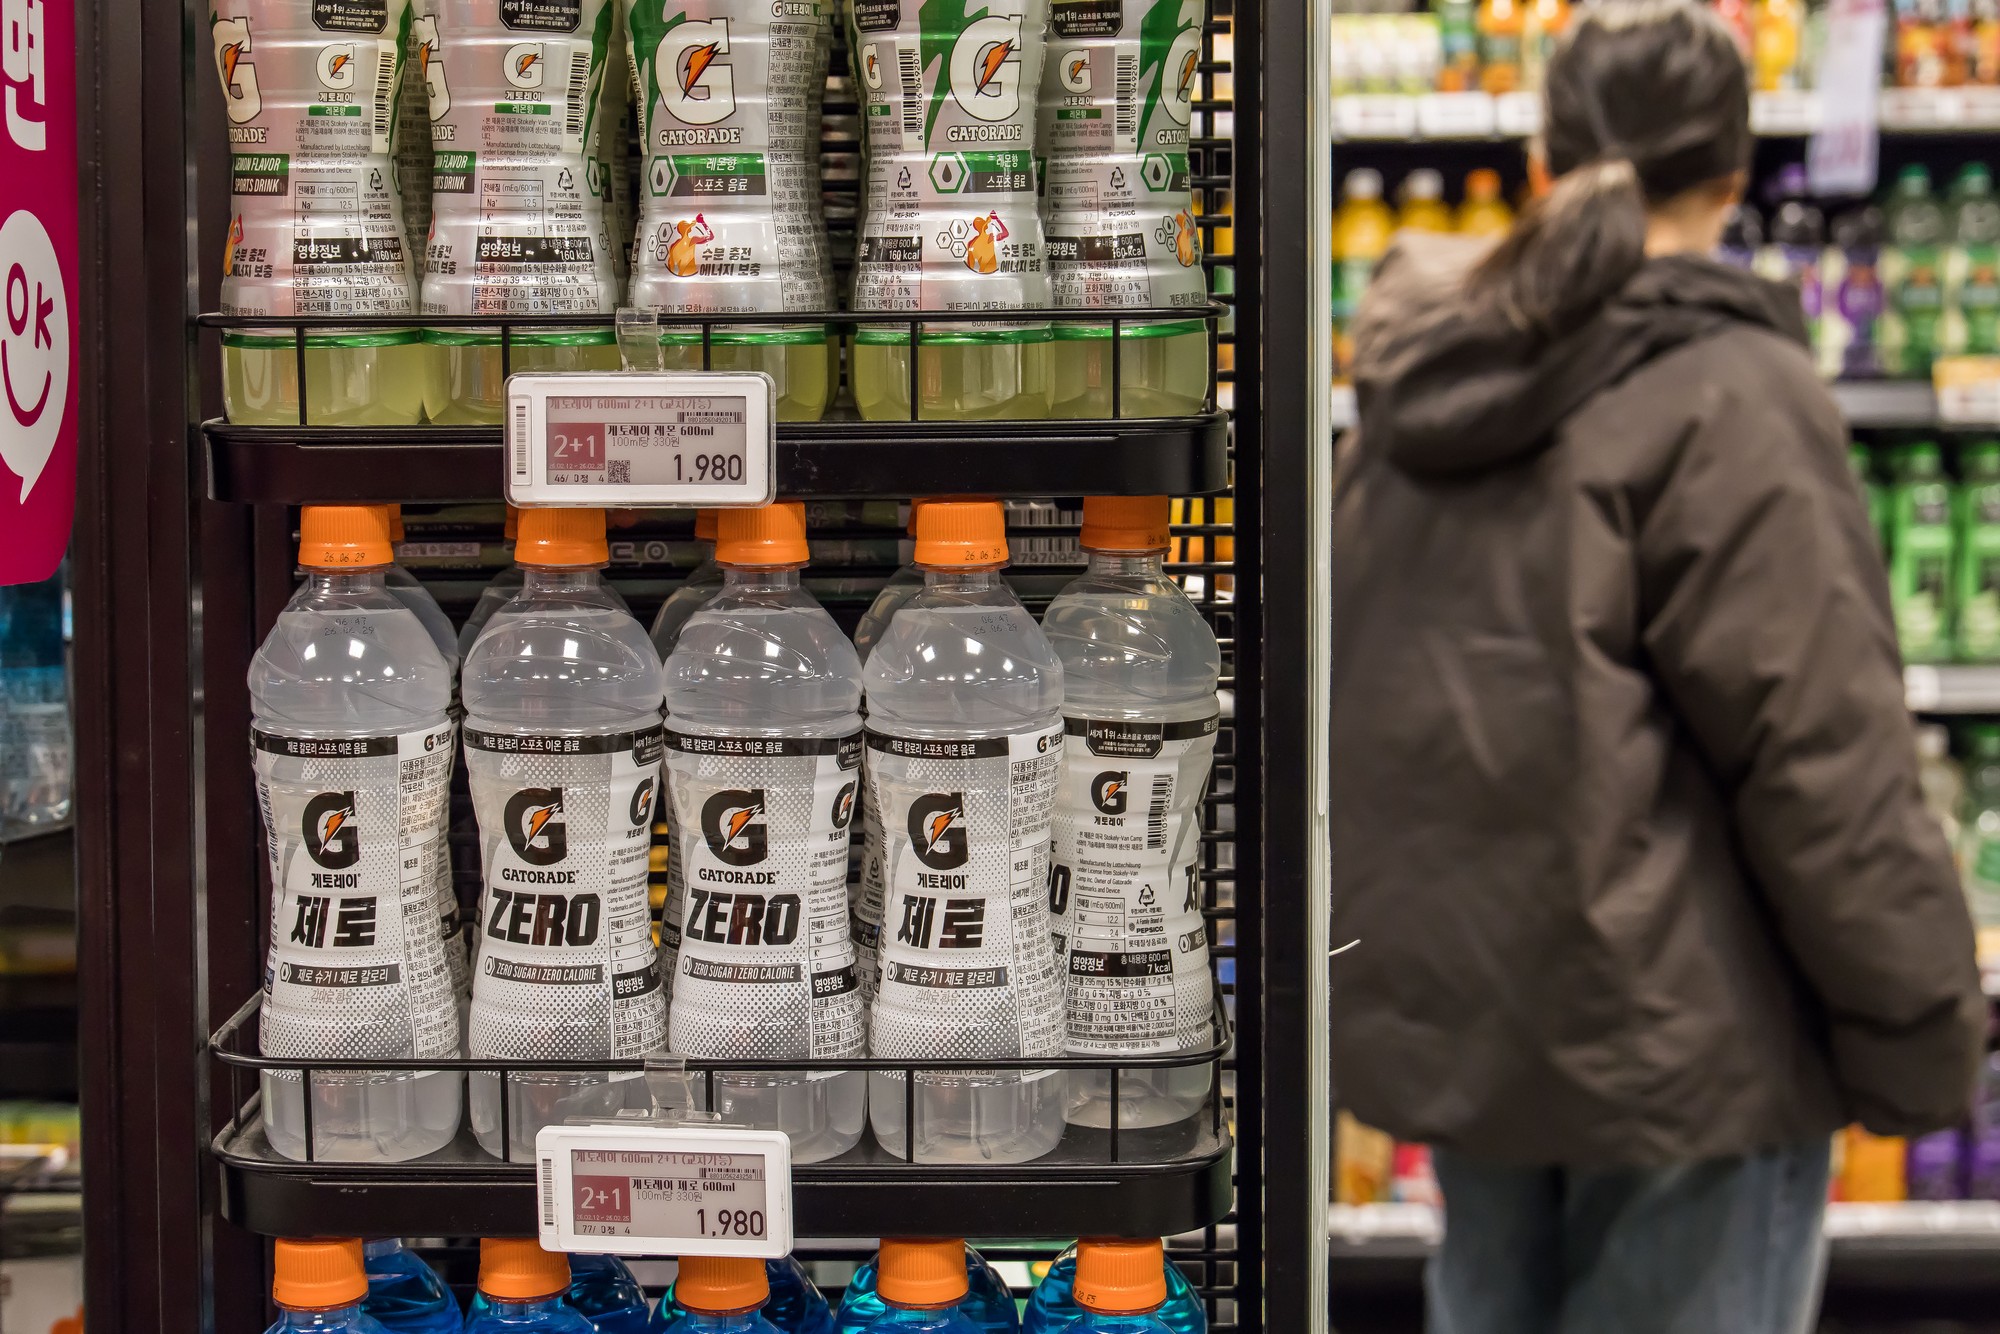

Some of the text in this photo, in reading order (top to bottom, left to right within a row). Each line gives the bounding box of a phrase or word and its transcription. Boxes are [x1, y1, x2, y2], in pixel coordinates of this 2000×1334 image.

[504, 2, 518, 10] 세계
[520, 0, 533, 12] 1위
[534, 4, 560, 13] 스포츠음료
[913, 52, 921, 89] 049201
[506, 91, 541, 101] 게토레이
[512, 105, 533, 113] 레몬향
[916, 93, 924, 129] 801056
[659, 128, 740, 146] GATORADE
[947, 126, 1021, 142] GATORADE
[252, 157, 280, 170] FLAVOR
[706, 157, 737, 171] 레몬향
[255, 178, 279, 192] DRINK
[693, 178, 748, 192] 스포츠 음료
[987, 174, 1026, 188] 스포츠 음료
[249, 249, 267, 261] 충전
[702, 247, 752, 261] 수분 충전
[1001, 244, 1036, 257] 수분 충전
[254, 265, 273, 278] 보충
[700, 263, 761, 277] 에너지 보충
[1000, 259, 1041, 273] 에너지 보충
[6, 262, 53, 351] OK
[550, 399, 592, 410] 게토레이
[597, 400, 630, 409] 600ml
[635, 400, 655, 409] 2+1
[607, 425, 713, 436] 게토레이 레몬 600ml
[554, 434, 595, 458] 2+1
[612, 437, 680, 447] 100ml당 330원
[674, 454, 742, 482] 1,980
[554, 474, 568, 482] 46/
[598, 474, 604, 482] 4
[324, 552, 365, 562] 26.06.29
[965, 548, 1000, 561] 26.06.29
[1090, 729, 1103, 738] 세계
[1104, 728, 1116, 739] 1위
[1142, 733, 1161, 741] 게토레이
[287, 741, 367, 755] 제로 칼로리 스포츠 이온 음료
[483, 737, 579, 752] 제로 칼로리 스포츠 이온 음료
[681, 738, 783, 753] 제로 칼로리 스포츠 이온 음료
[892, 740, 975, 756] 제로 칼로리 스포츠 이온 음료
[1094, 816, 1123, 827] 게토레이
[311, 873, 358, 889] 게토레이
[502, 868, 576, 884] GATORADE
[699, 868, 776, 884] GATORADE
[917, 873, 965, 890] 게토레이
[291, 895, 377, 948] 제로
[487, 887, 600, 946] ZERO
[686, 888, 801, 946] ZERO
[898, 894, 986, 949] 제로
[1136, 926, 1163, 934] PEPSICO
[1072, 957, 1104, 971] 영양정보
[1121, 952, 1169, 964] 총 내용량 600 ml
[496, 962, 597, 981] ZERO SUGAR ZERO CALORIE
[693, 963, 794, 980] ZERO SUGAR ZERO CALORIE
[1148, 962, 1170, 974] 7 kcal
[297, 968, 388, 983] 제로 슈거 제로 칼로리
[903, 967, 996, 985] 제로 슈거 제로 칼로리
[1123, 978, 1147, 987] 탄수화물
[576, 1152, 616, 1164] 게토레이
[621, 1153, 653, 1164] 600ml
[658, 1154, 677, 1165] 2+1
[632, 1178, 735, 1192] 게토레이 제로 600ml
[581, 1187, 621, 1210] 2+1
[636, 1191, 702, 1203] 100ml당 330원
[583, 1224, 596, 1234] 77/
[625, 1226, 630, 1234] 4
[697, 1209, 764, 1237] 1,980
